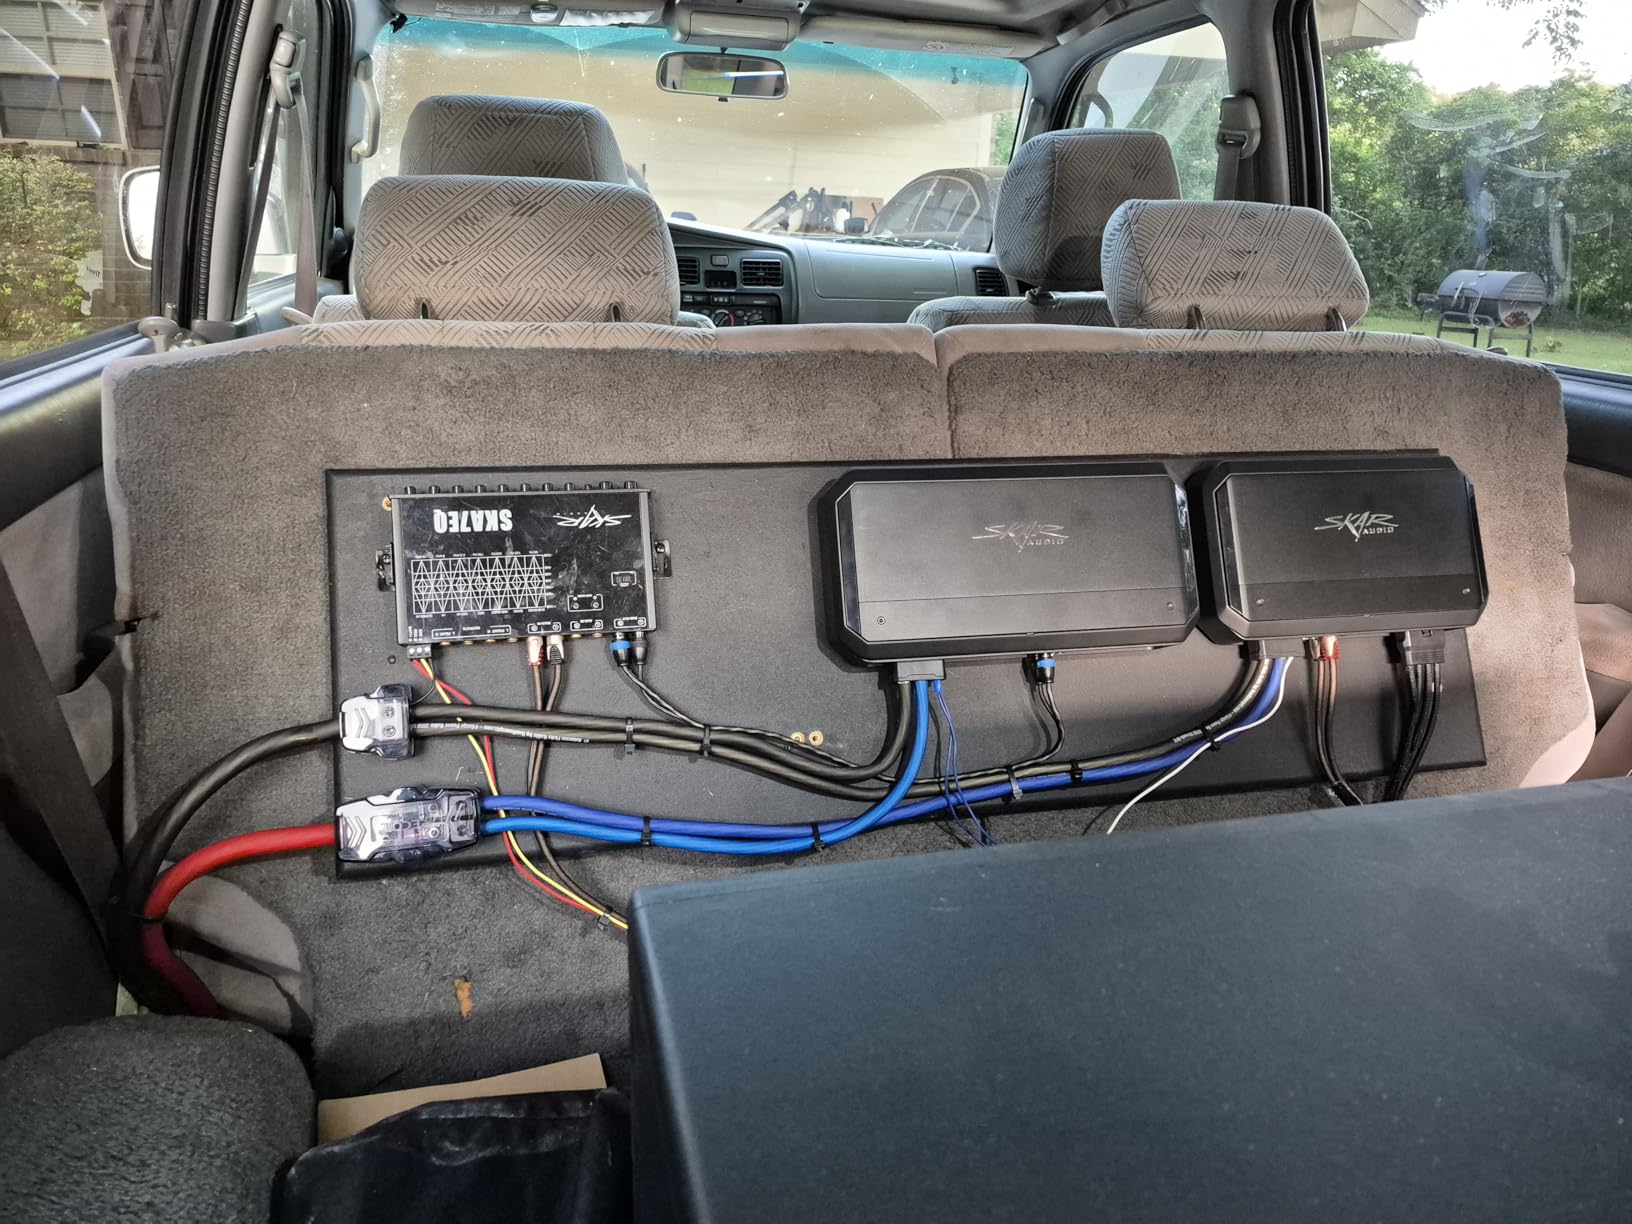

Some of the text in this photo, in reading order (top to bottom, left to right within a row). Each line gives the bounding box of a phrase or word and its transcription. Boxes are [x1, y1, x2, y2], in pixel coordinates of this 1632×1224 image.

[433, 508, 513, 534] SKA7EQ
[552, 504, 632, 529] SKAR
[1314, 511, 1399, 542] SKAR
[971, 520, 1070, 553] SKAR
[1362, 526, 1395, 535] AUDIO
